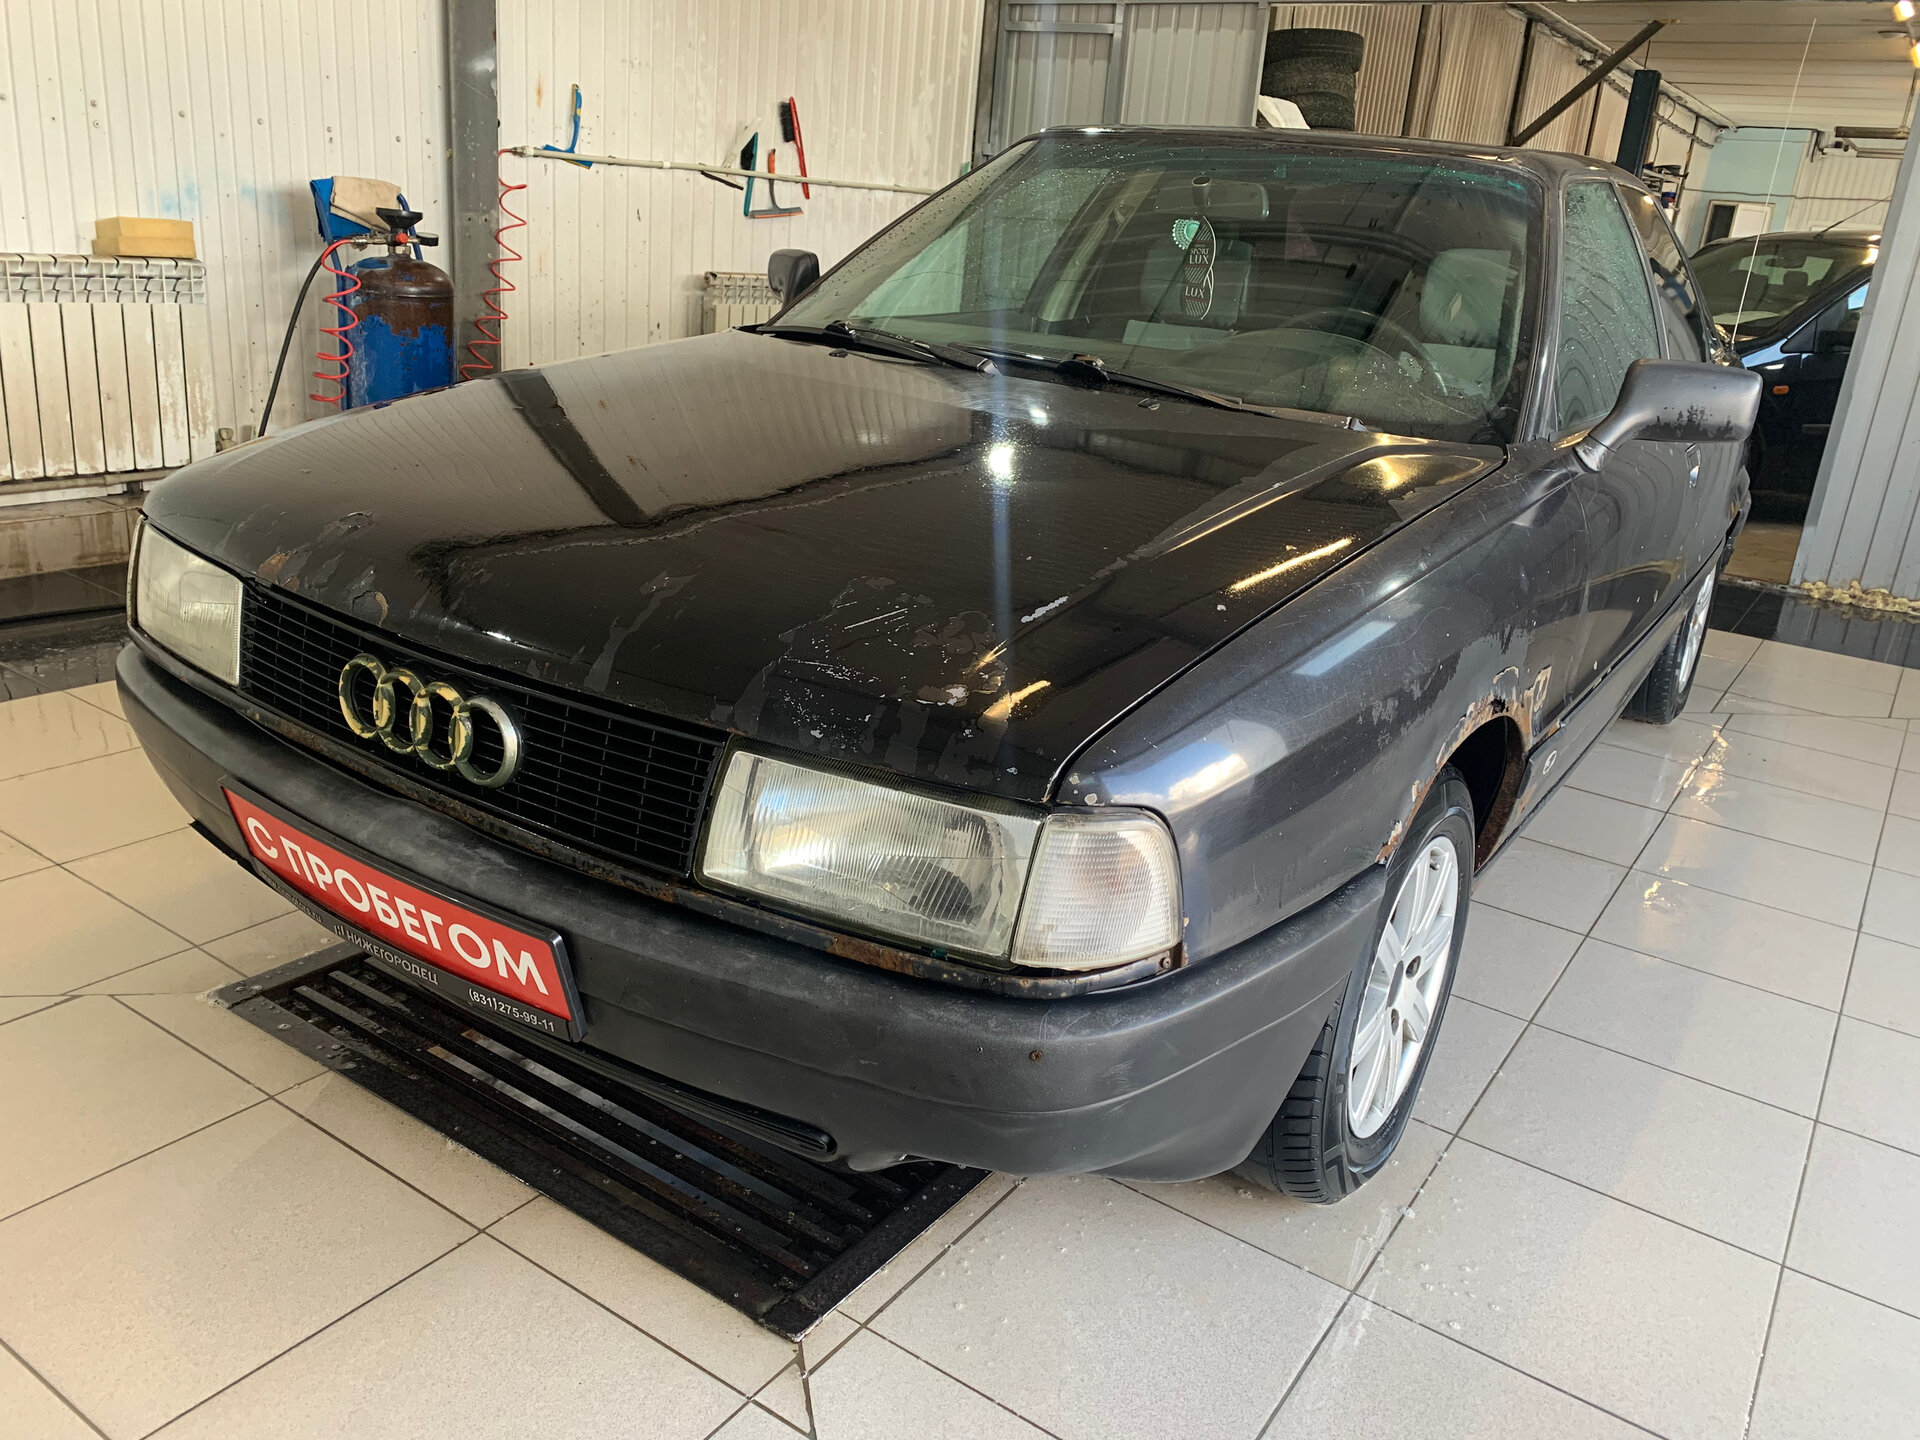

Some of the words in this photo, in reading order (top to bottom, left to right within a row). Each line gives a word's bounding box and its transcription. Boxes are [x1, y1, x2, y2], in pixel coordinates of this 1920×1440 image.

[1189, 255, 1209, 264] LUX
[1185, 286, 1204, 298] LUX
[246, 816, 278, 860] С
[279, 835, 549, 996] ПРОБЕГОМ
[346, 930, 438, 985] НИЖЕГОРОДЕЦ
